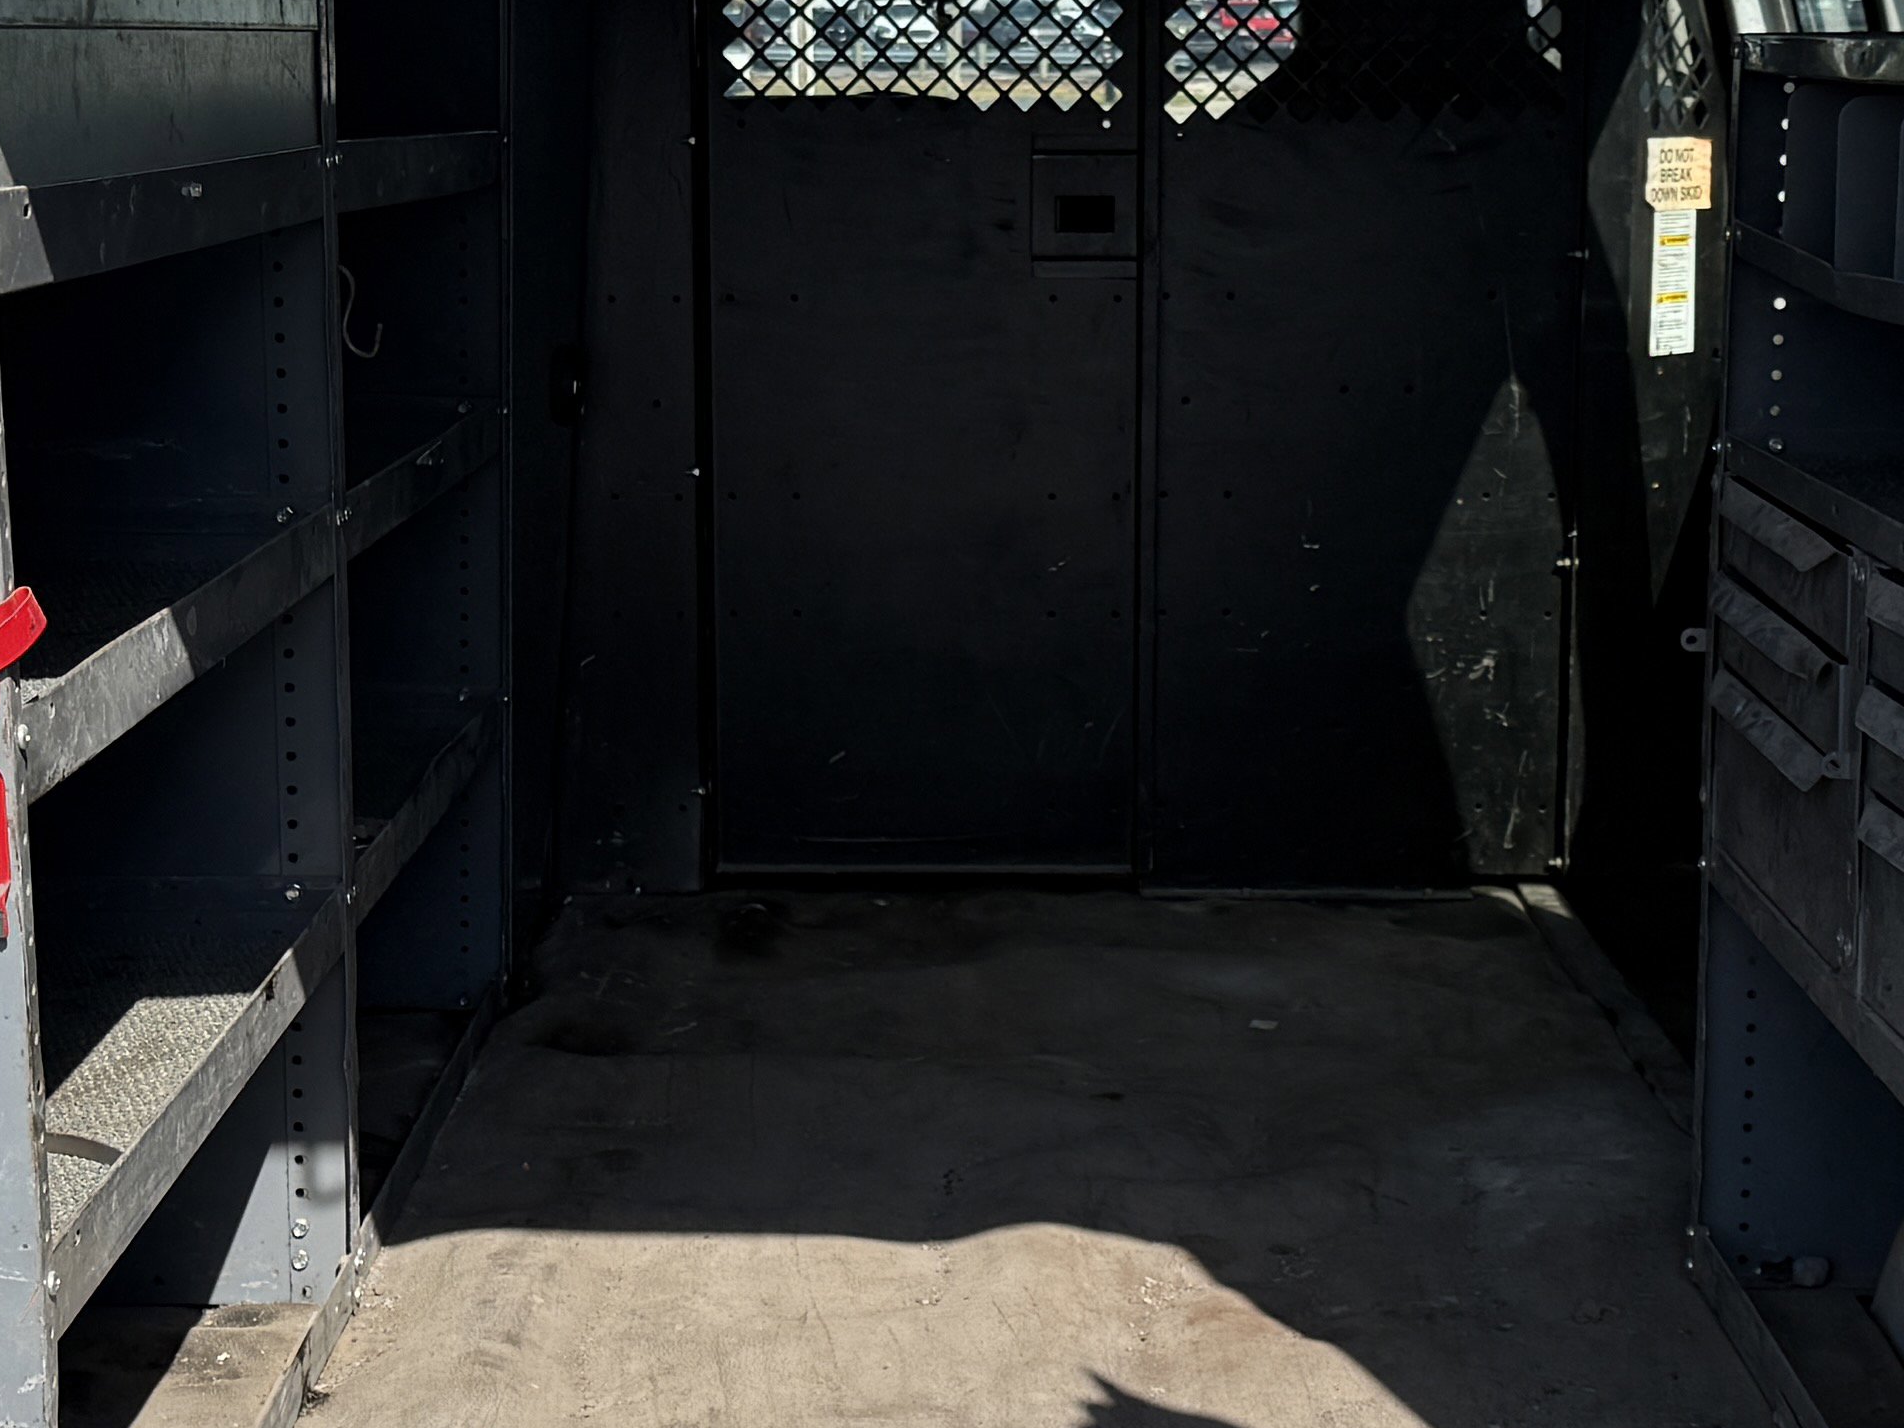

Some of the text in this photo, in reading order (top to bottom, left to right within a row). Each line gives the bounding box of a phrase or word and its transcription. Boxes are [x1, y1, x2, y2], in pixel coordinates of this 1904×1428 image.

[1659, 148, 1695, 164] DO NOT
[1660, 167, 1693, 183] BREAK
[1651, 187, 1678, 203] DOWN
